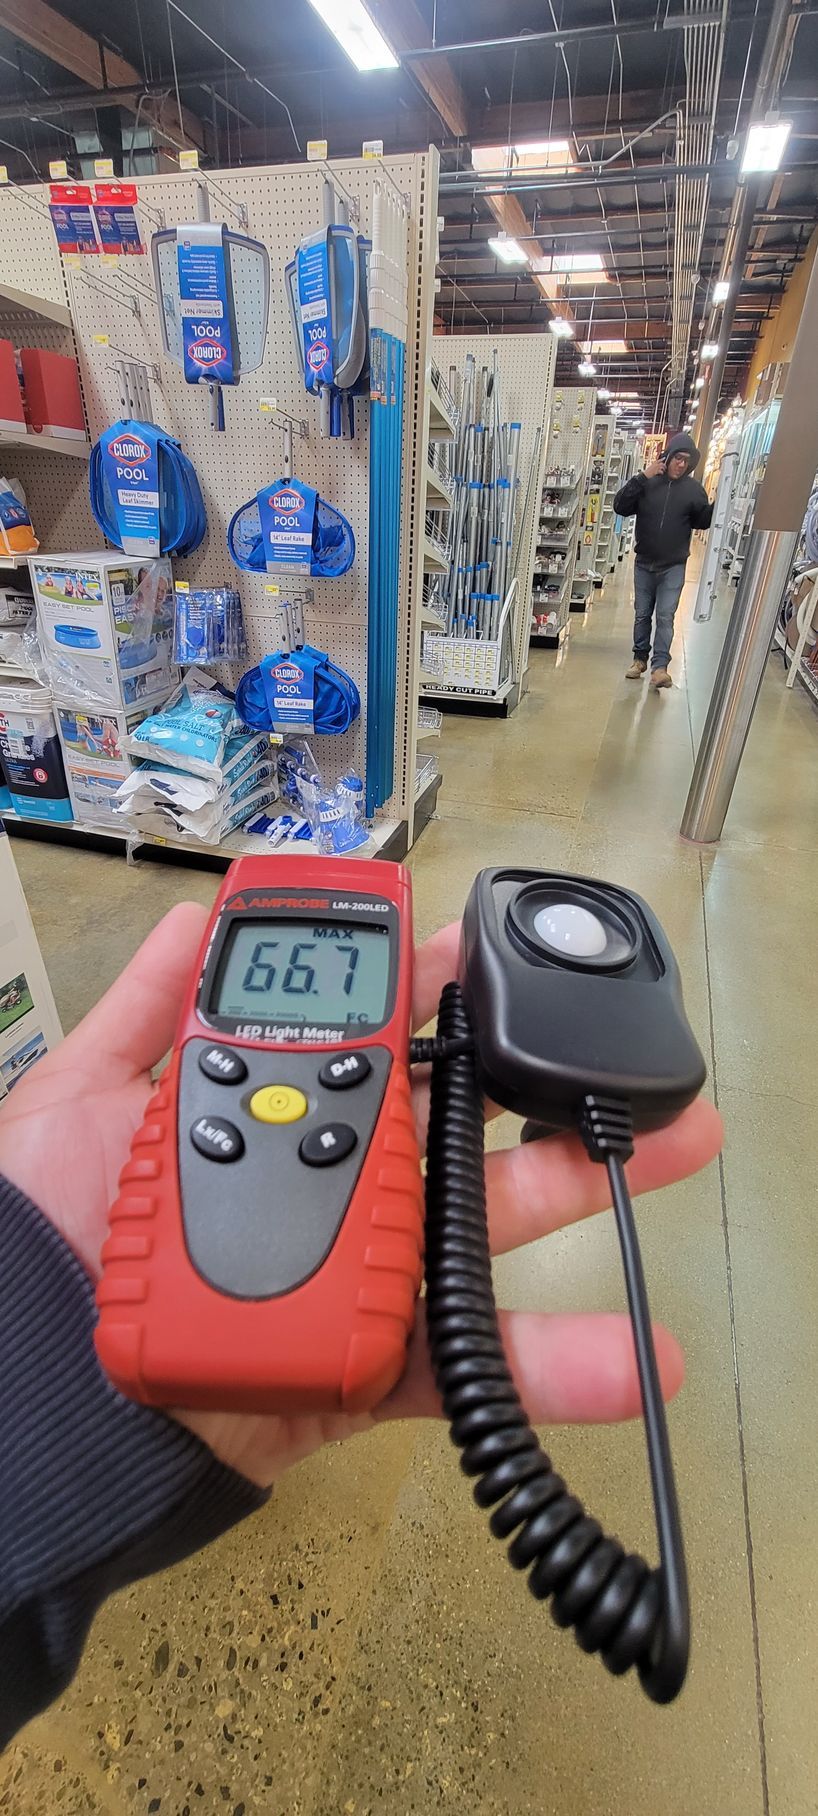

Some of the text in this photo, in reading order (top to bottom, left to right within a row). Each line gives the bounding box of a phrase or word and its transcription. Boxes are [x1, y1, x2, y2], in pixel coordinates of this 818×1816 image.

[191, 325, 221, 338] POOL
[308, 326, 327, 341] POOL
[192, 346, 222, 359] CLOROX
[113, 442, 146, 458] CLOROX
[116, 467, 149, 481] POOL
[121, 491, 149, 500] Heavy Duty
[273, 496, 300, 508] CLOROX
[274, 516, 300, 527] POOL
[274, 668, 300, 679] CLOROX
[276, 684, 301, 694] POOL
[184, 720, 205, 732] SALT
[181, 726, 217, 743] CHLORINATORS
[248, 897, 389, 913] AMPROBE LM-200LED
[313, 927, 354, 940] MAX
[242, 941, 360, 996] 66.7
[346, 1011, 369, 1024] FC
[234, 1024, 345, 1040] LED Light Meter
[206, 1049, 235, 1073] M-H
[330, 1056, 359, 1077] D-H
[319, 1131, 337, 1149] R
